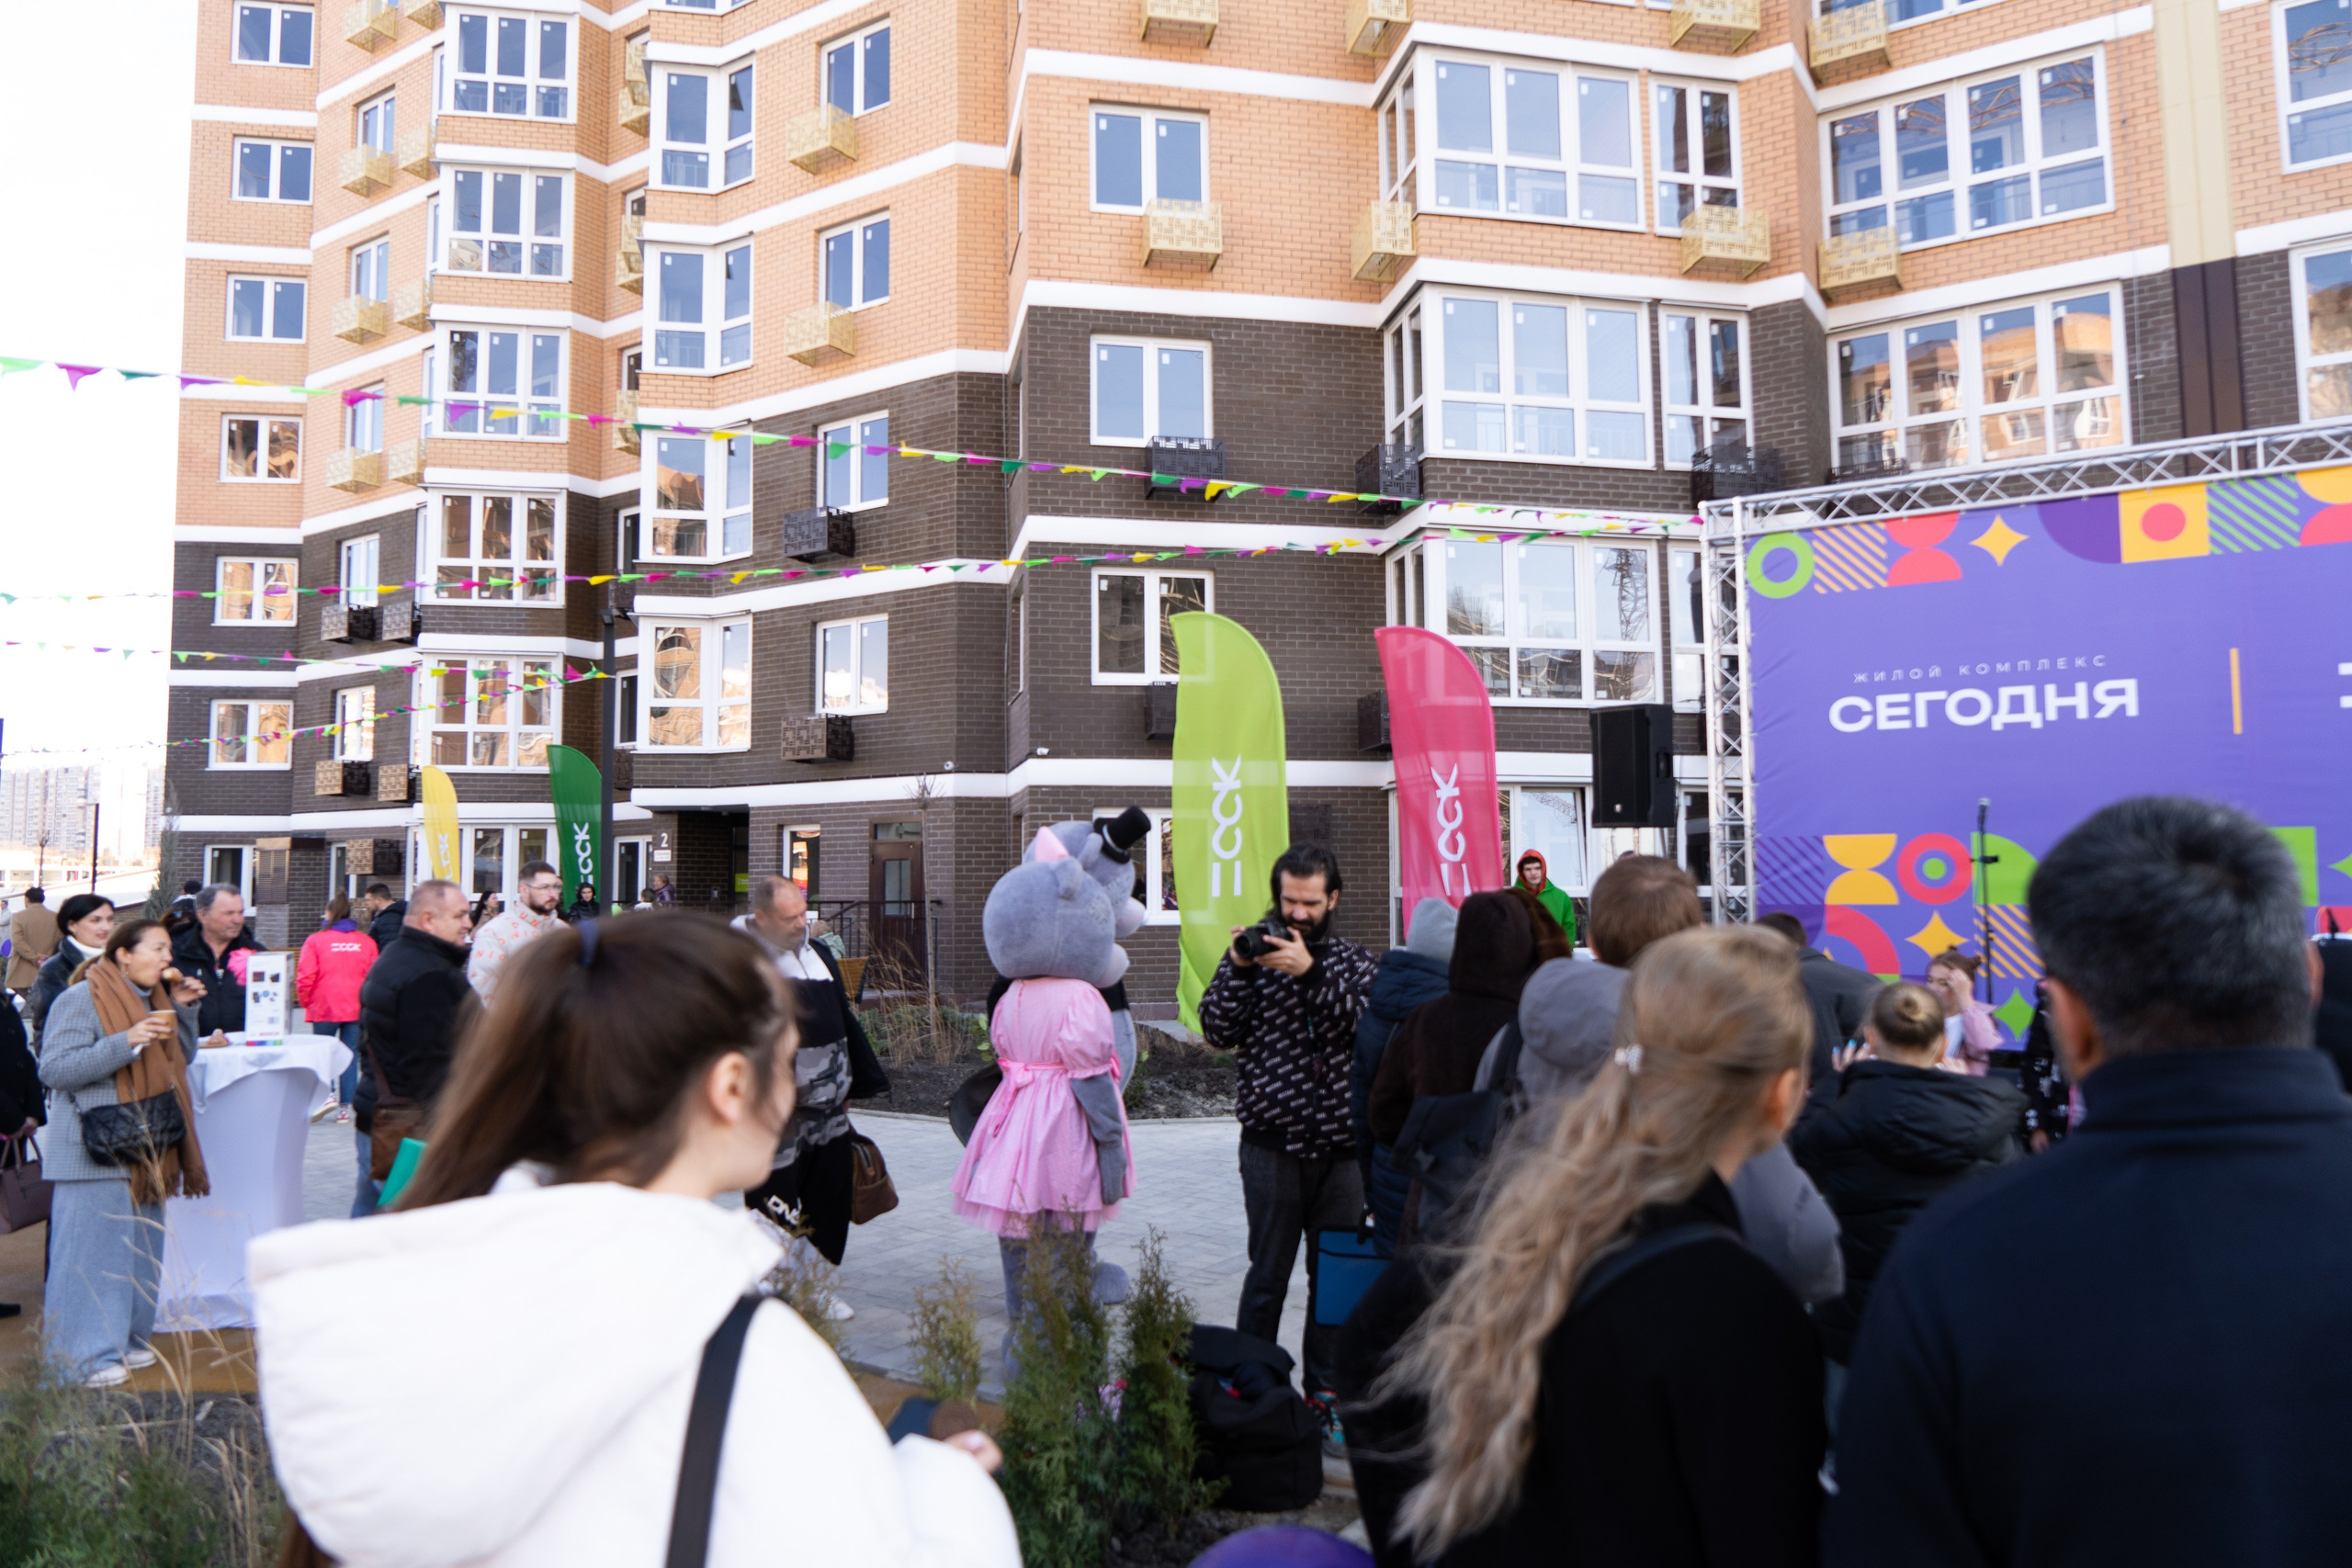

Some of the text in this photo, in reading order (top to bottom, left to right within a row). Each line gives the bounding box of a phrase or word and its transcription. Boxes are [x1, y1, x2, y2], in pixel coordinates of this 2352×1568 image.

[1853, 654, 2107, 683] ЖИЛОЙ КОМПЛЕКС
[1828, 678, 2139, 733] СЕГОДНЯ
[661, 832, 669, 848] 2
